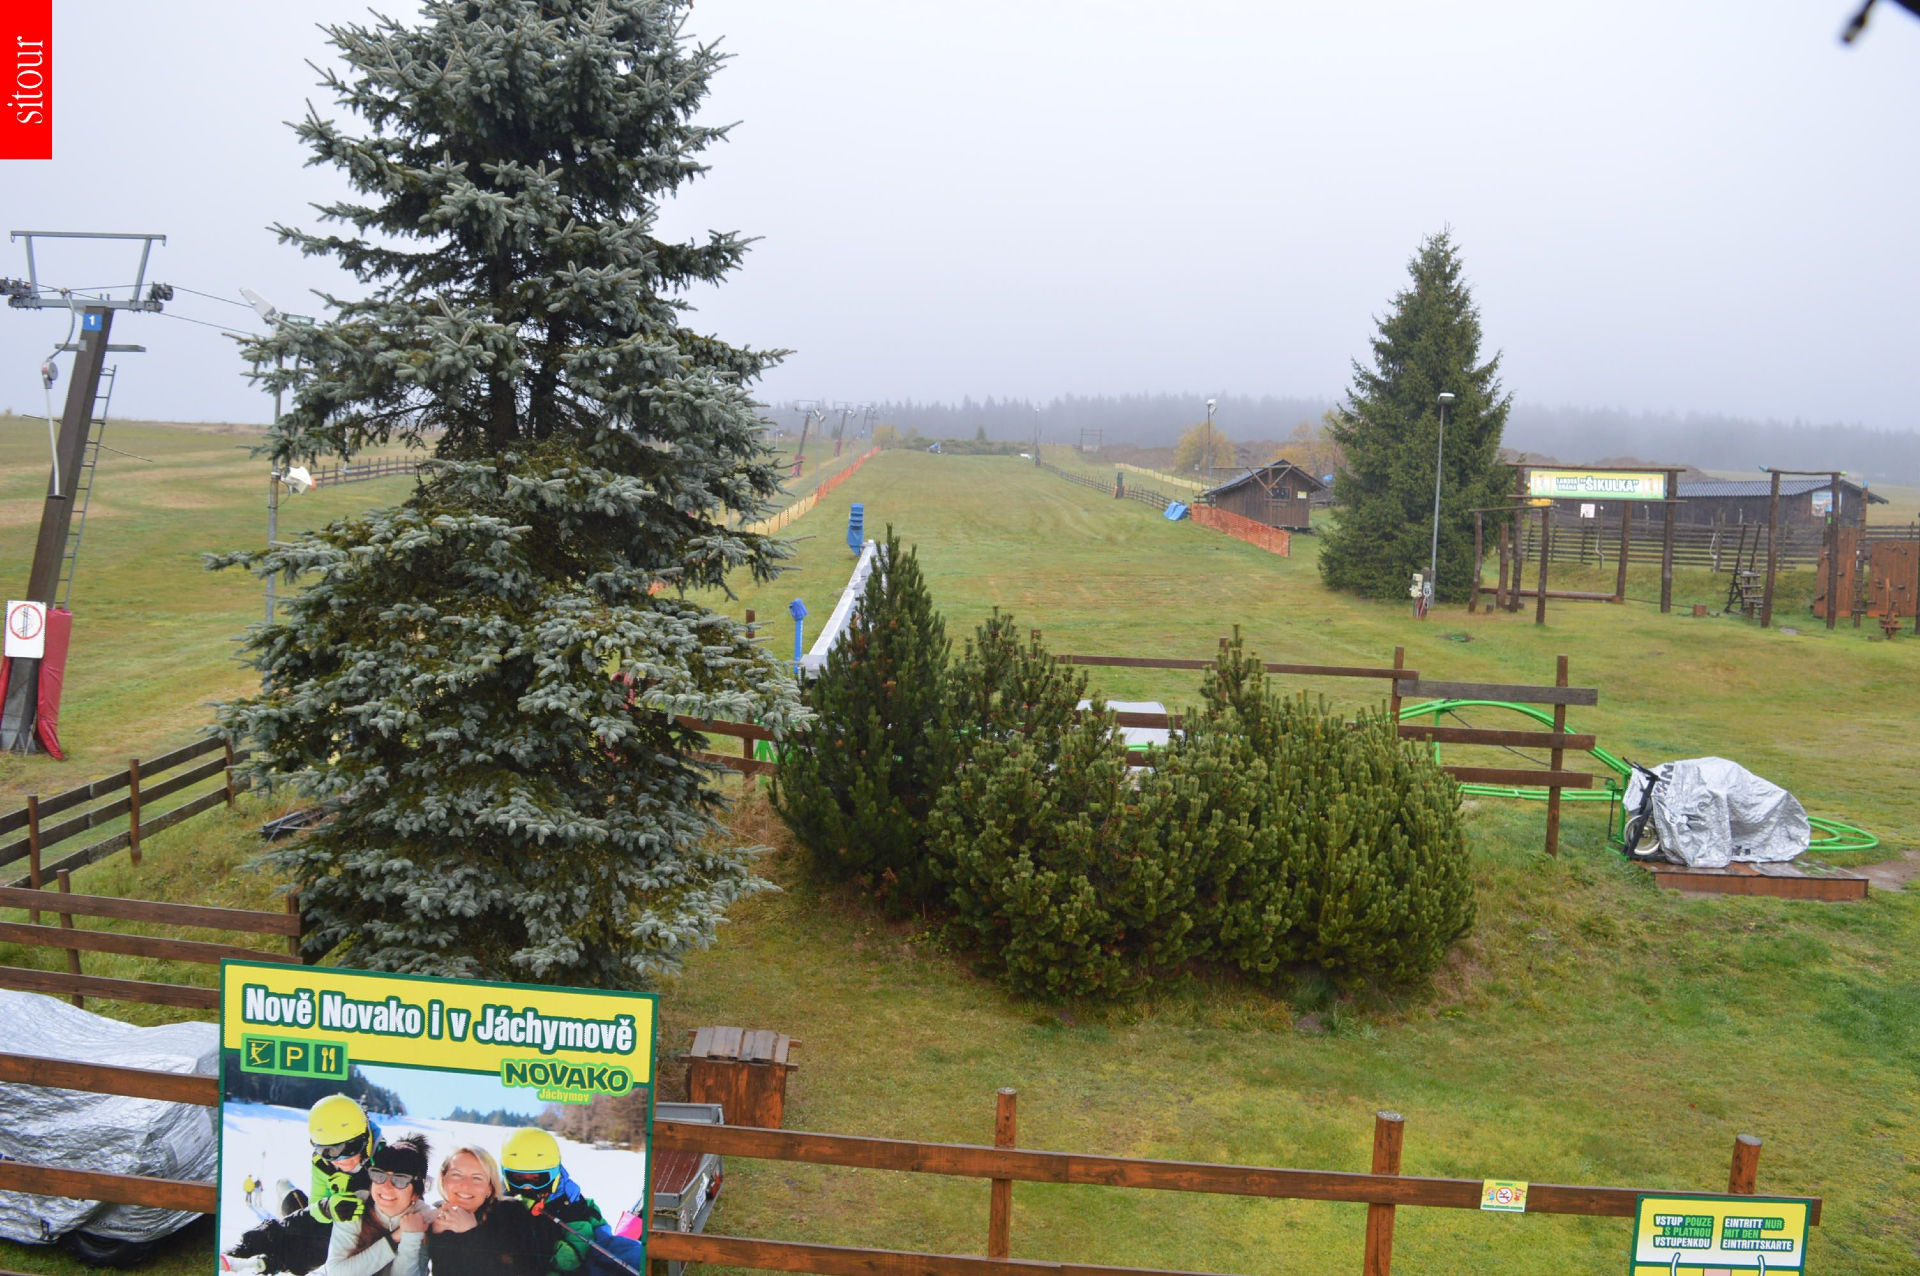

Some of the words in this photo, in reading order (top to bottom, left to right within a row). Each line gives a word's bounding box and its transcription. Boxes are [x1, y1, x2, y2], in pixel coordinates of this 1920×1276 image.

[89, 315, 95, 326] 1
[246, 988, 312, 1024] Nově
[322, 994, 421, 1034] Novako
[431, 1004, 440, 1036] i
[450, 1012, 467, 1038] v
[477, 1008, 632, 1050] Jáchymově
[286, 1046, 303, 1067] P
[505, 1062, 629, 1092] NOVAKO
[1655, 1215, 1683, 1226] VSTUP
[1685, 1216, 1713, 1227] POUZE
[1725, 1218, 1763, 1228] EINTRITT
[1764, 1219, 1783, 1229] NUR
[1665, 1227, 1670, 1235] S
[1673, 1227, 1711, 1237] PLATNOU
[1724, 1229, 1740, 1238] MIT
[1742, 1229, 1759, 1239] DEN
[1655, 1237, 1710, 1248] VSTUPENKOU
[1722, 1239, 1792, 1250] EINTRITTSKARTE
